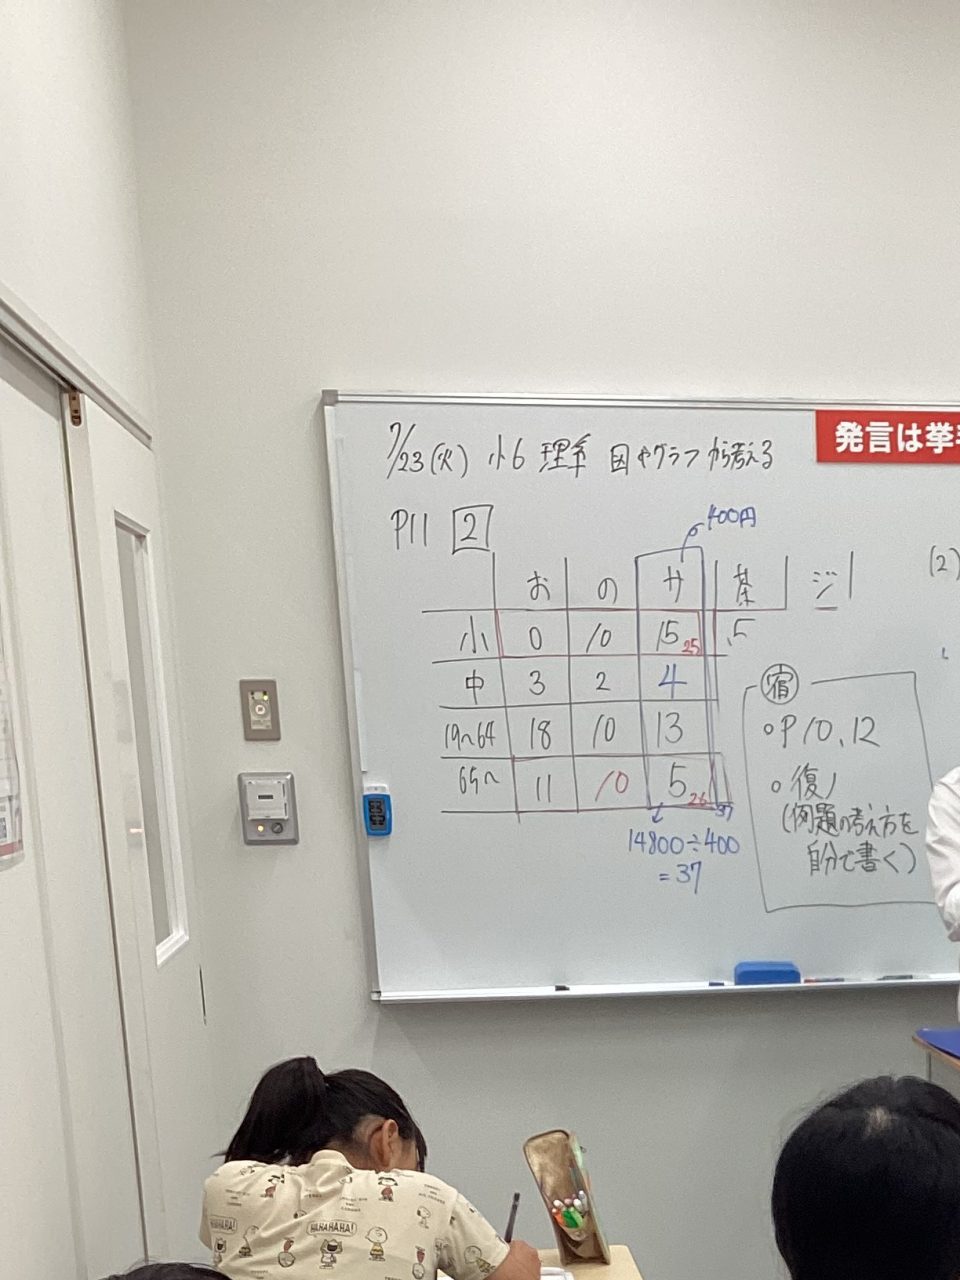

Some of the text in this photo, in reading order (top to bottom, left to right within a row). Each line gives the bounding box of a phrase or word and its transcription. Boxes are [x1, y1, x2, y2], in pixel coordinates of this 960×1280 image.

[460, 512, 477, 541] 2
[465, 669, 485, 705] 中
[529, 670, 546, 695] 3
[596, 672, 611, 691] 2
[658, 663, 688, 699] 4
[530, 717, 551, 750] 18
[593, 714, 616, 749] 10
[656, 712, 684, 748] 13
[668, 762, 687, 798] 5
